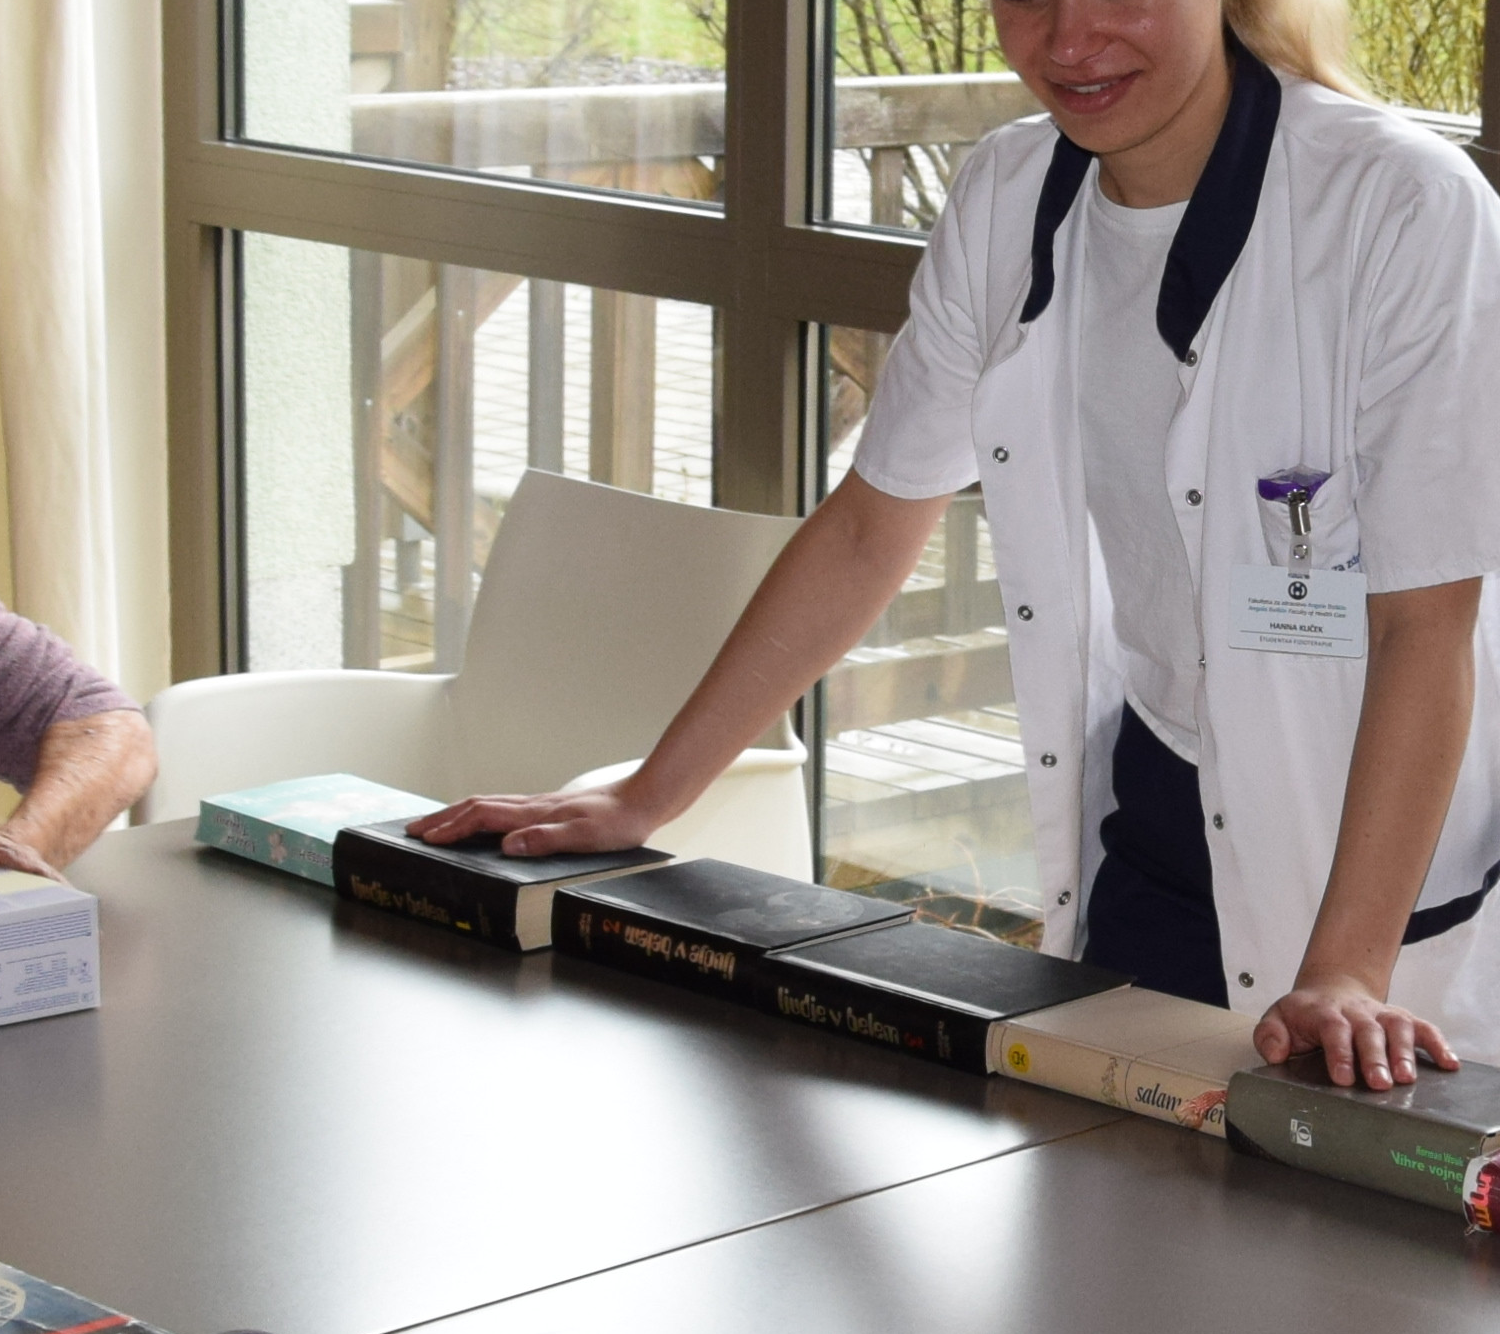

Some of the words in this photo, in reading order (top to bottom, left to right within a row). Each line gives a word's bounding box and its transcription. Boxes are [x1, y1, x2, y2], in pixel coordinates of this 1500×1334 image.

[624, 925, 673, 962] belem
[674, 940, 687, 960] v
[688, 944, 736, 982] ljudje
[777, 986, 827, 1023] ljudje
[829, 1009, 842, 1027] v
[846, 1006, 900, 1045] belem
[1390, 1149, 1426, 1172] Vihre
[1428, 1165, 1464, 1182] vojne
